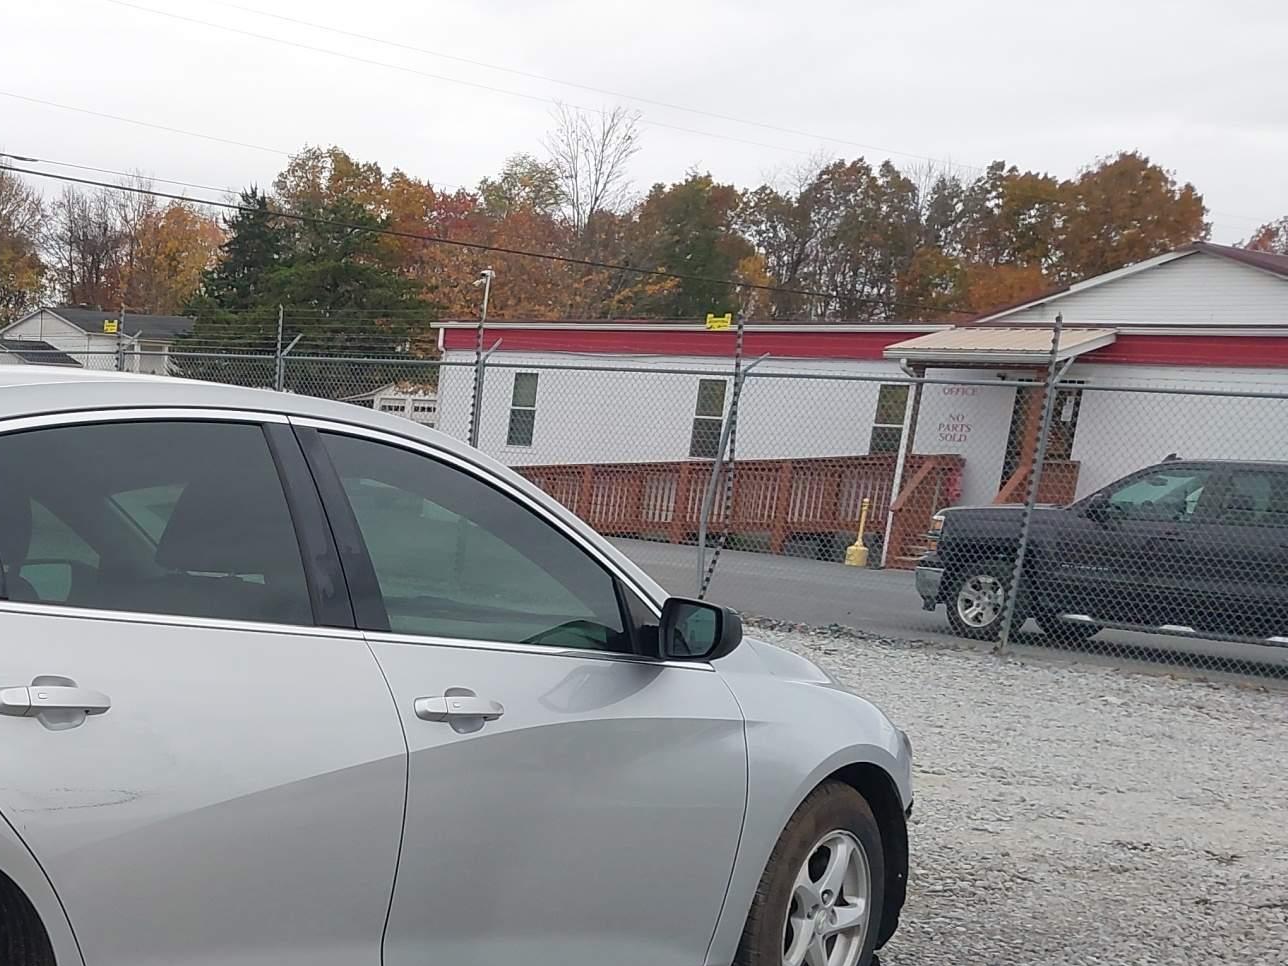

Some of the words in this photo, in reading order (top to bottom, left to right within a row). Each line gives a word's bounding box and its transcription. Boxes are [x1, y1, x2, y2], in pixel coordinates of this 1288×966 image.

[943, 387, 978, 396] OFFICE
[949, 413, 965, 422] NO
[938, 423, 972, 432] PARTS
[938, 433, 967, 442] SOLD
